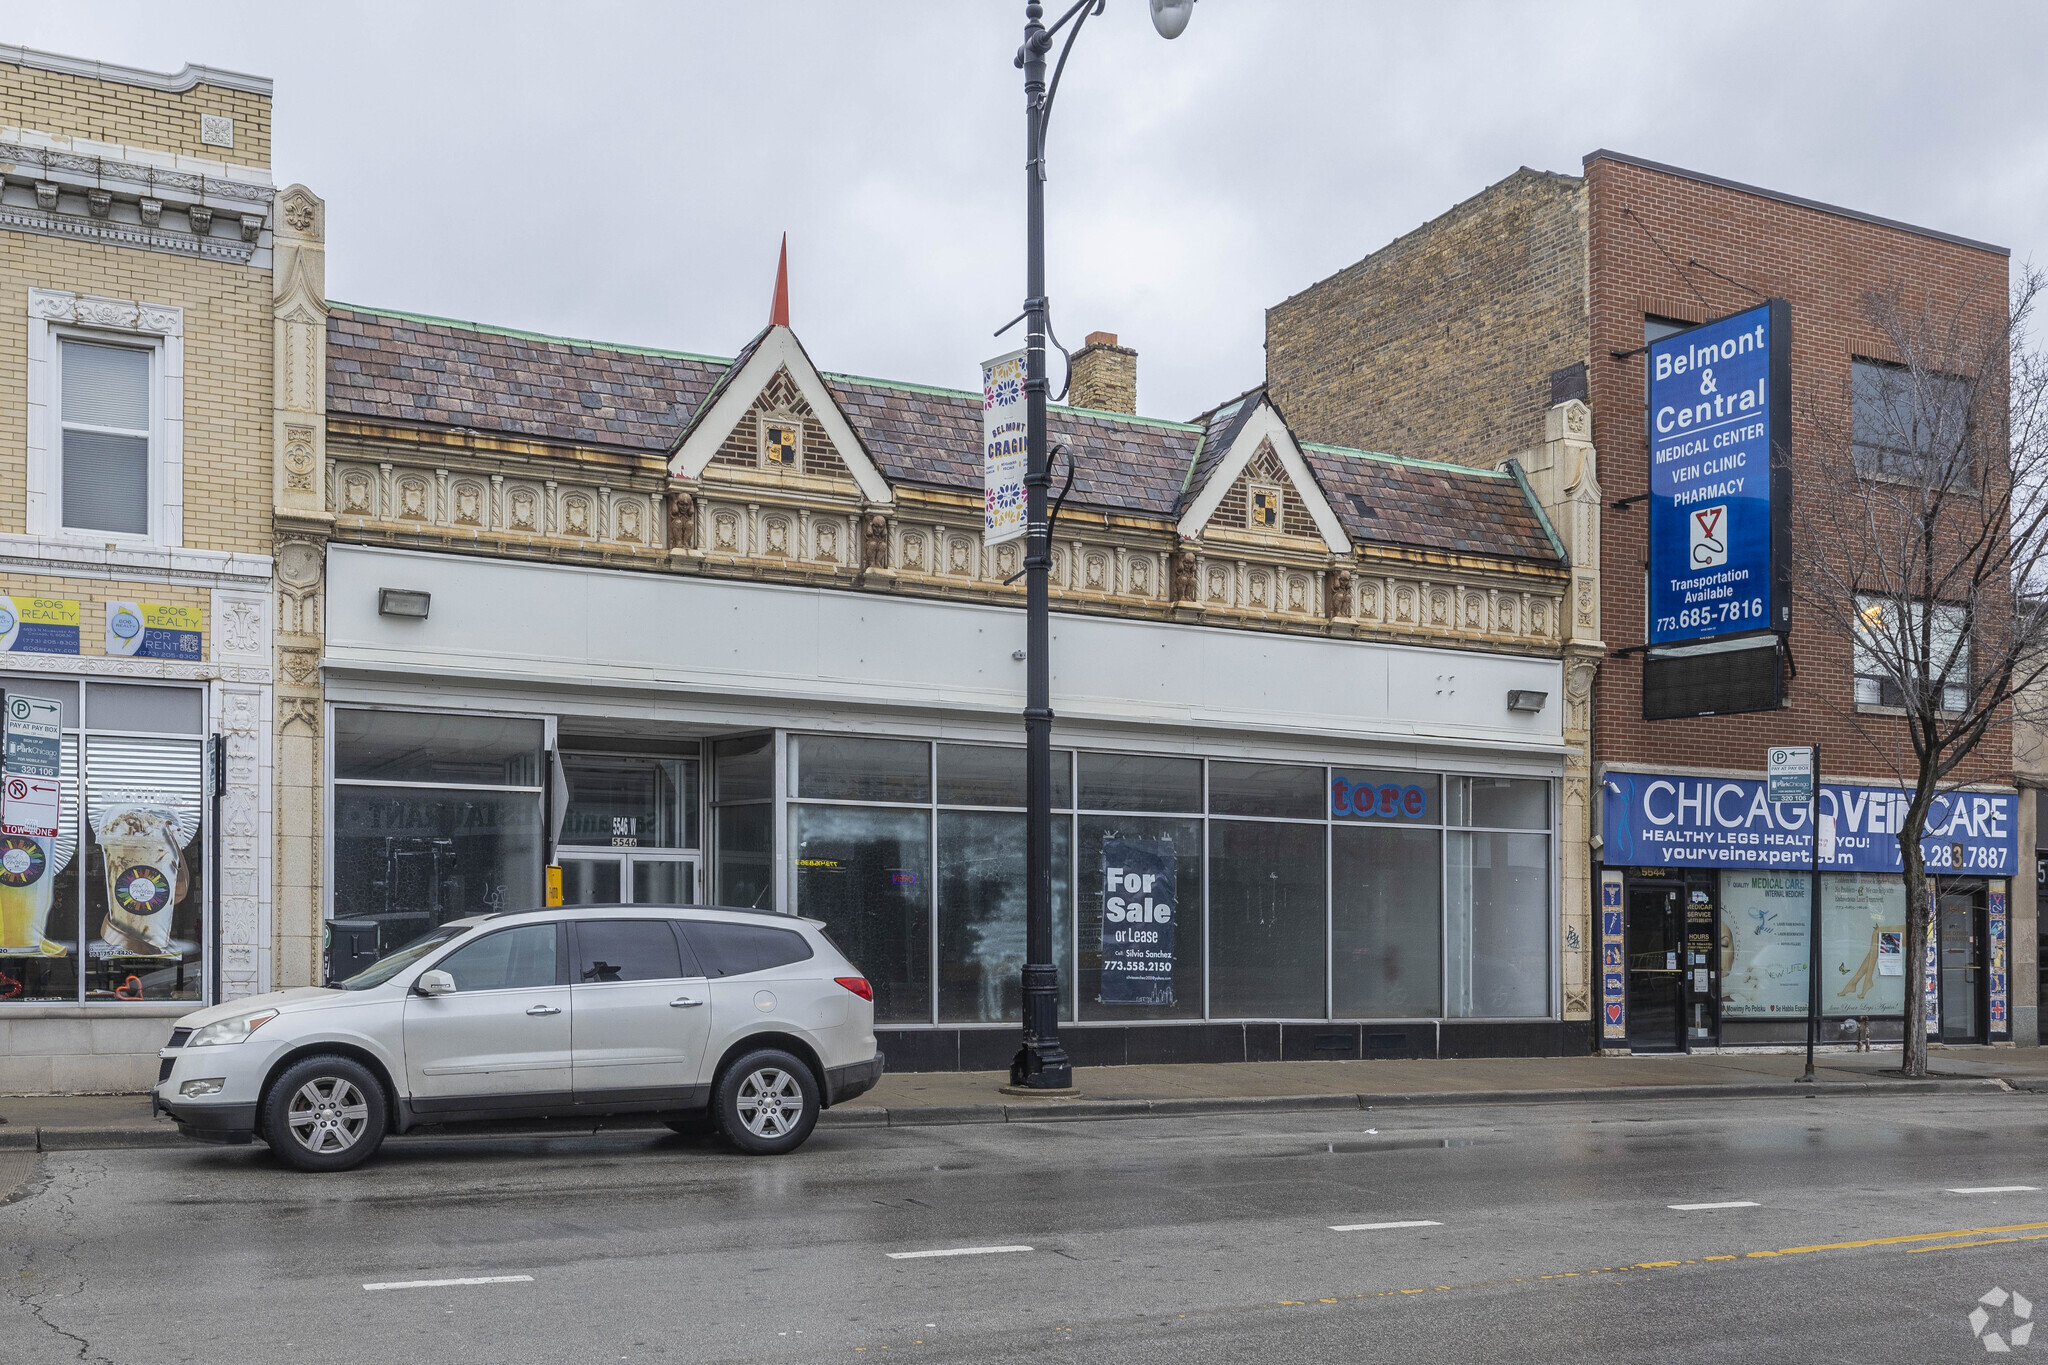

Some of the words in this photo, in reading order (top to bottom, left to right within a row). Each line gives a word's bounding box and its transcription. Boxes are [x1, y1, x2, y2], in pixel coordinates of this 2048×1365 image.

[1656, 324, 1765, 381] Belmont
[1700, 368, 1718, 395] &
[1656, 378, 1765, 433] Central
[991, 421, 1026, 438] BELMONT
[1656, 438, 1710, 464] MEDICAL
[1713, 423, 1764, 448] CENTER
[1672, 464, 1700, 484] VEIN
[1703, 452, 1746, 475] CLINIC
[1674, 477, 1745, 507] PHARMACY
[1670, 569, 1749, 592] Transportation
[1684, 585, 1734, 604] Available
[33, 599, 64, 610] 606
[158, 606, 188, 617] 606
[21, 608, 76, 621] REALTY
[1656, 597, 1763, 633] 773.685-7816
[146, 615, 200, 629] REALTY
[145, 630, 172, 641] FOR
[42, 639, 78, 647] 205-8300
[145, 640, 180, 651] RENT
[160, 652, 199, 660] 205-8300
[16, 743, 58, 757] ParkChicago
[21, 766, 37, 774] 320
[38, 767, 54, 776] 106
[1924, 795, 2008, 838] CARE
[612, 817, 629, 836] 5546
[629, 817, 637, 836] W
[612, 838, 637, 848] 5546
[1641, 829, 1715, 843] HEALTHY
[1717, 832, 1760, 845] LEGS
[1763, 834, 1814, 847] HEALT
[1835, 836, 1870, 848] YOU!
[1895, 843, 2008, 870] 73.283.7887
[1641, 868, 1666, 877] 5544
[1106, 867, 1156, 894] For
[1751, 877, 1784, 890] MEDICAL
[1784, 878, 1805, 890] CARE
[1765, 890, 1785, 898] INTERNAL
[1785, 890, 1805, 898] MEDICINE
[1106, 896, 1171, 924] Sale
[1115, 930, 1126, 943] or
[1128, 927, 1159, 943] Lease
[1125, 948, 1144, 958] Silvia
[1145, 949, 1172, 959] Sanchez
[1104, 960, 1172, 972] 773.558.2150
[1765, 968, 1785, 980] NEW
[1744, 1004, 1751, 1012] Po
[1751, 1004, 1766, 1012] Polsku
[1775, 1004, 1782, 1012] Se
[1782, 1004, 1795, 1012] Habla
